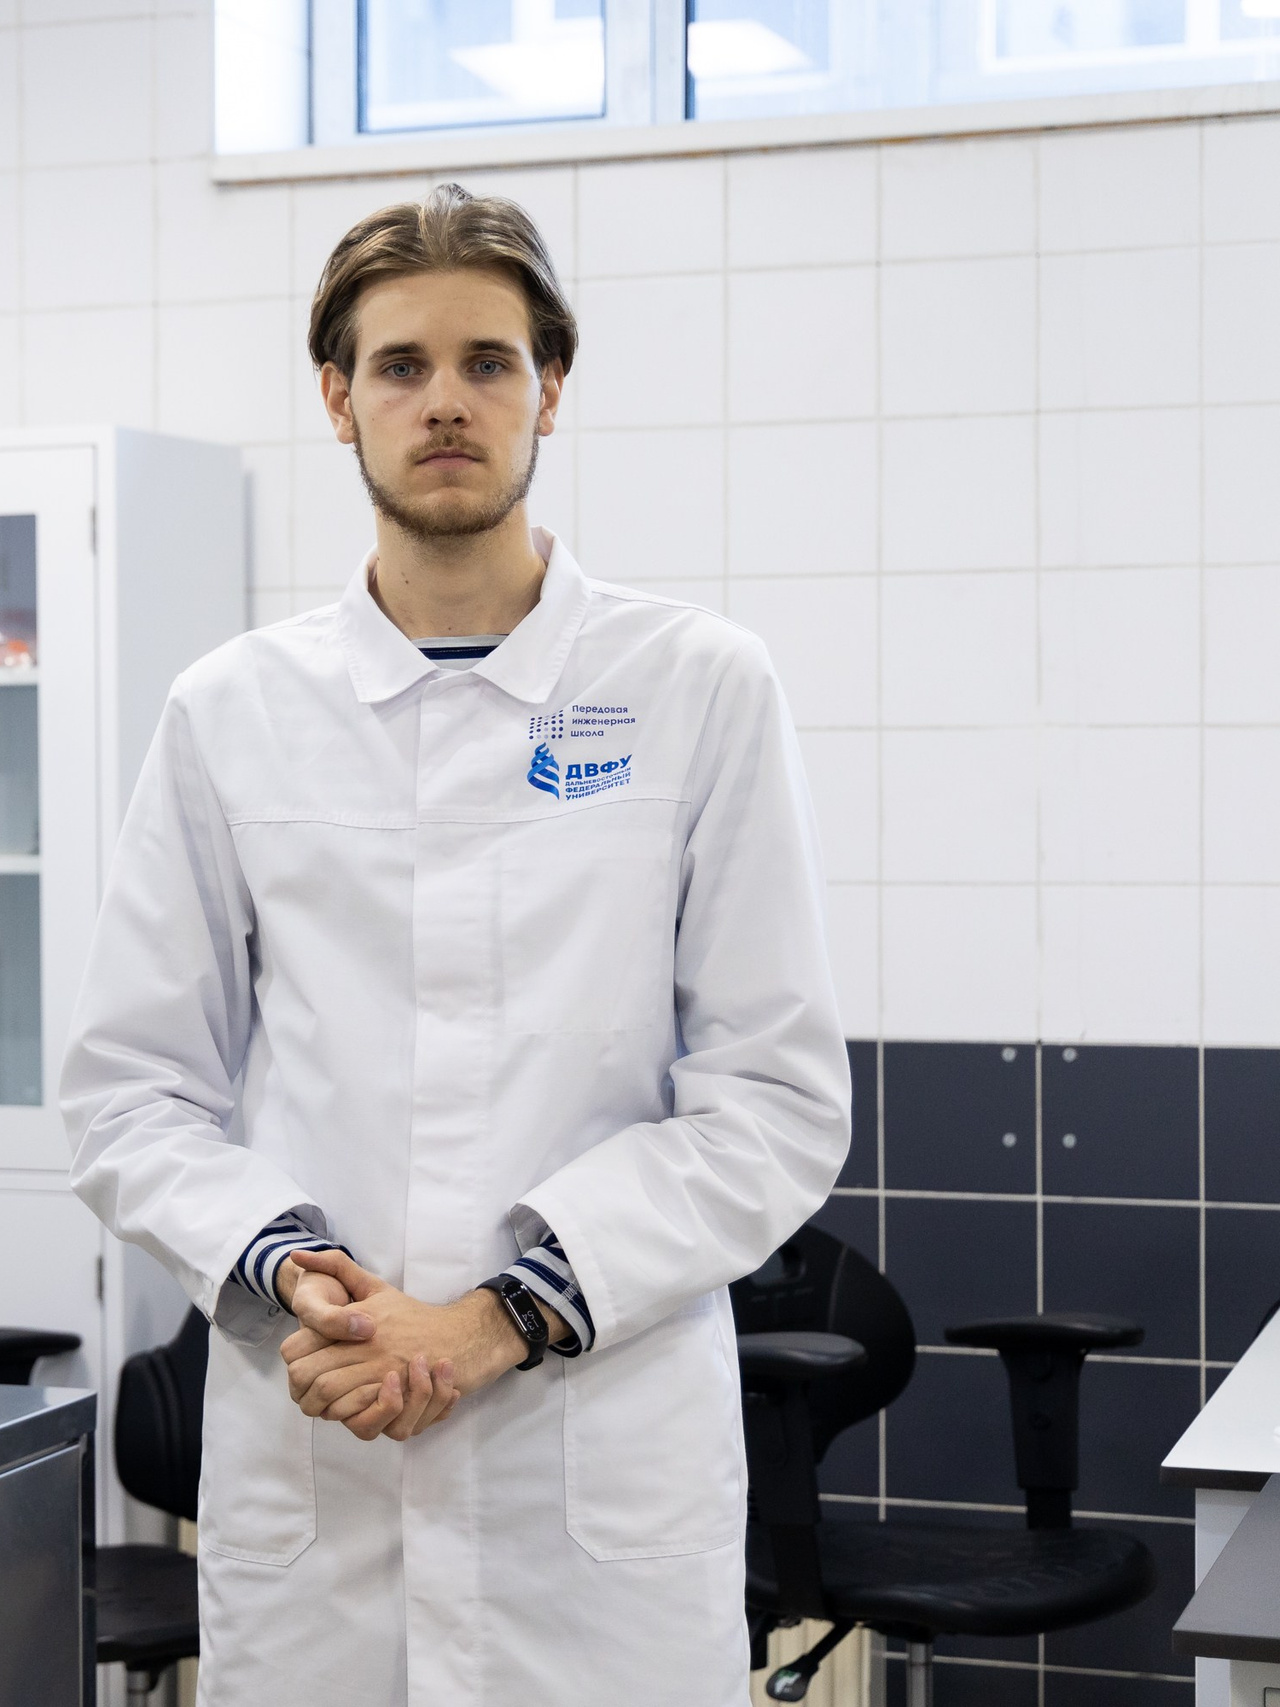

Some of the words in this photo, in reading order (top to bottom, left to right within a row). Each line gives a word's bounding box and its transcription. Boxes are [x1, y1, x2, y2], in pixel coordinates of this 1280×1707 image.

[572, 705, 628, 714] Передовая
[572, 717, 636, 726] инженерная
[570, 729, 604, 737] школа
[565, 754, 633, 780] ДВФУ
[565, 772, 631, 793] ФЕДЕРАЛЬНЫЙ
[565, 778, 631, 800] УНИВЕРСИТЕТ
